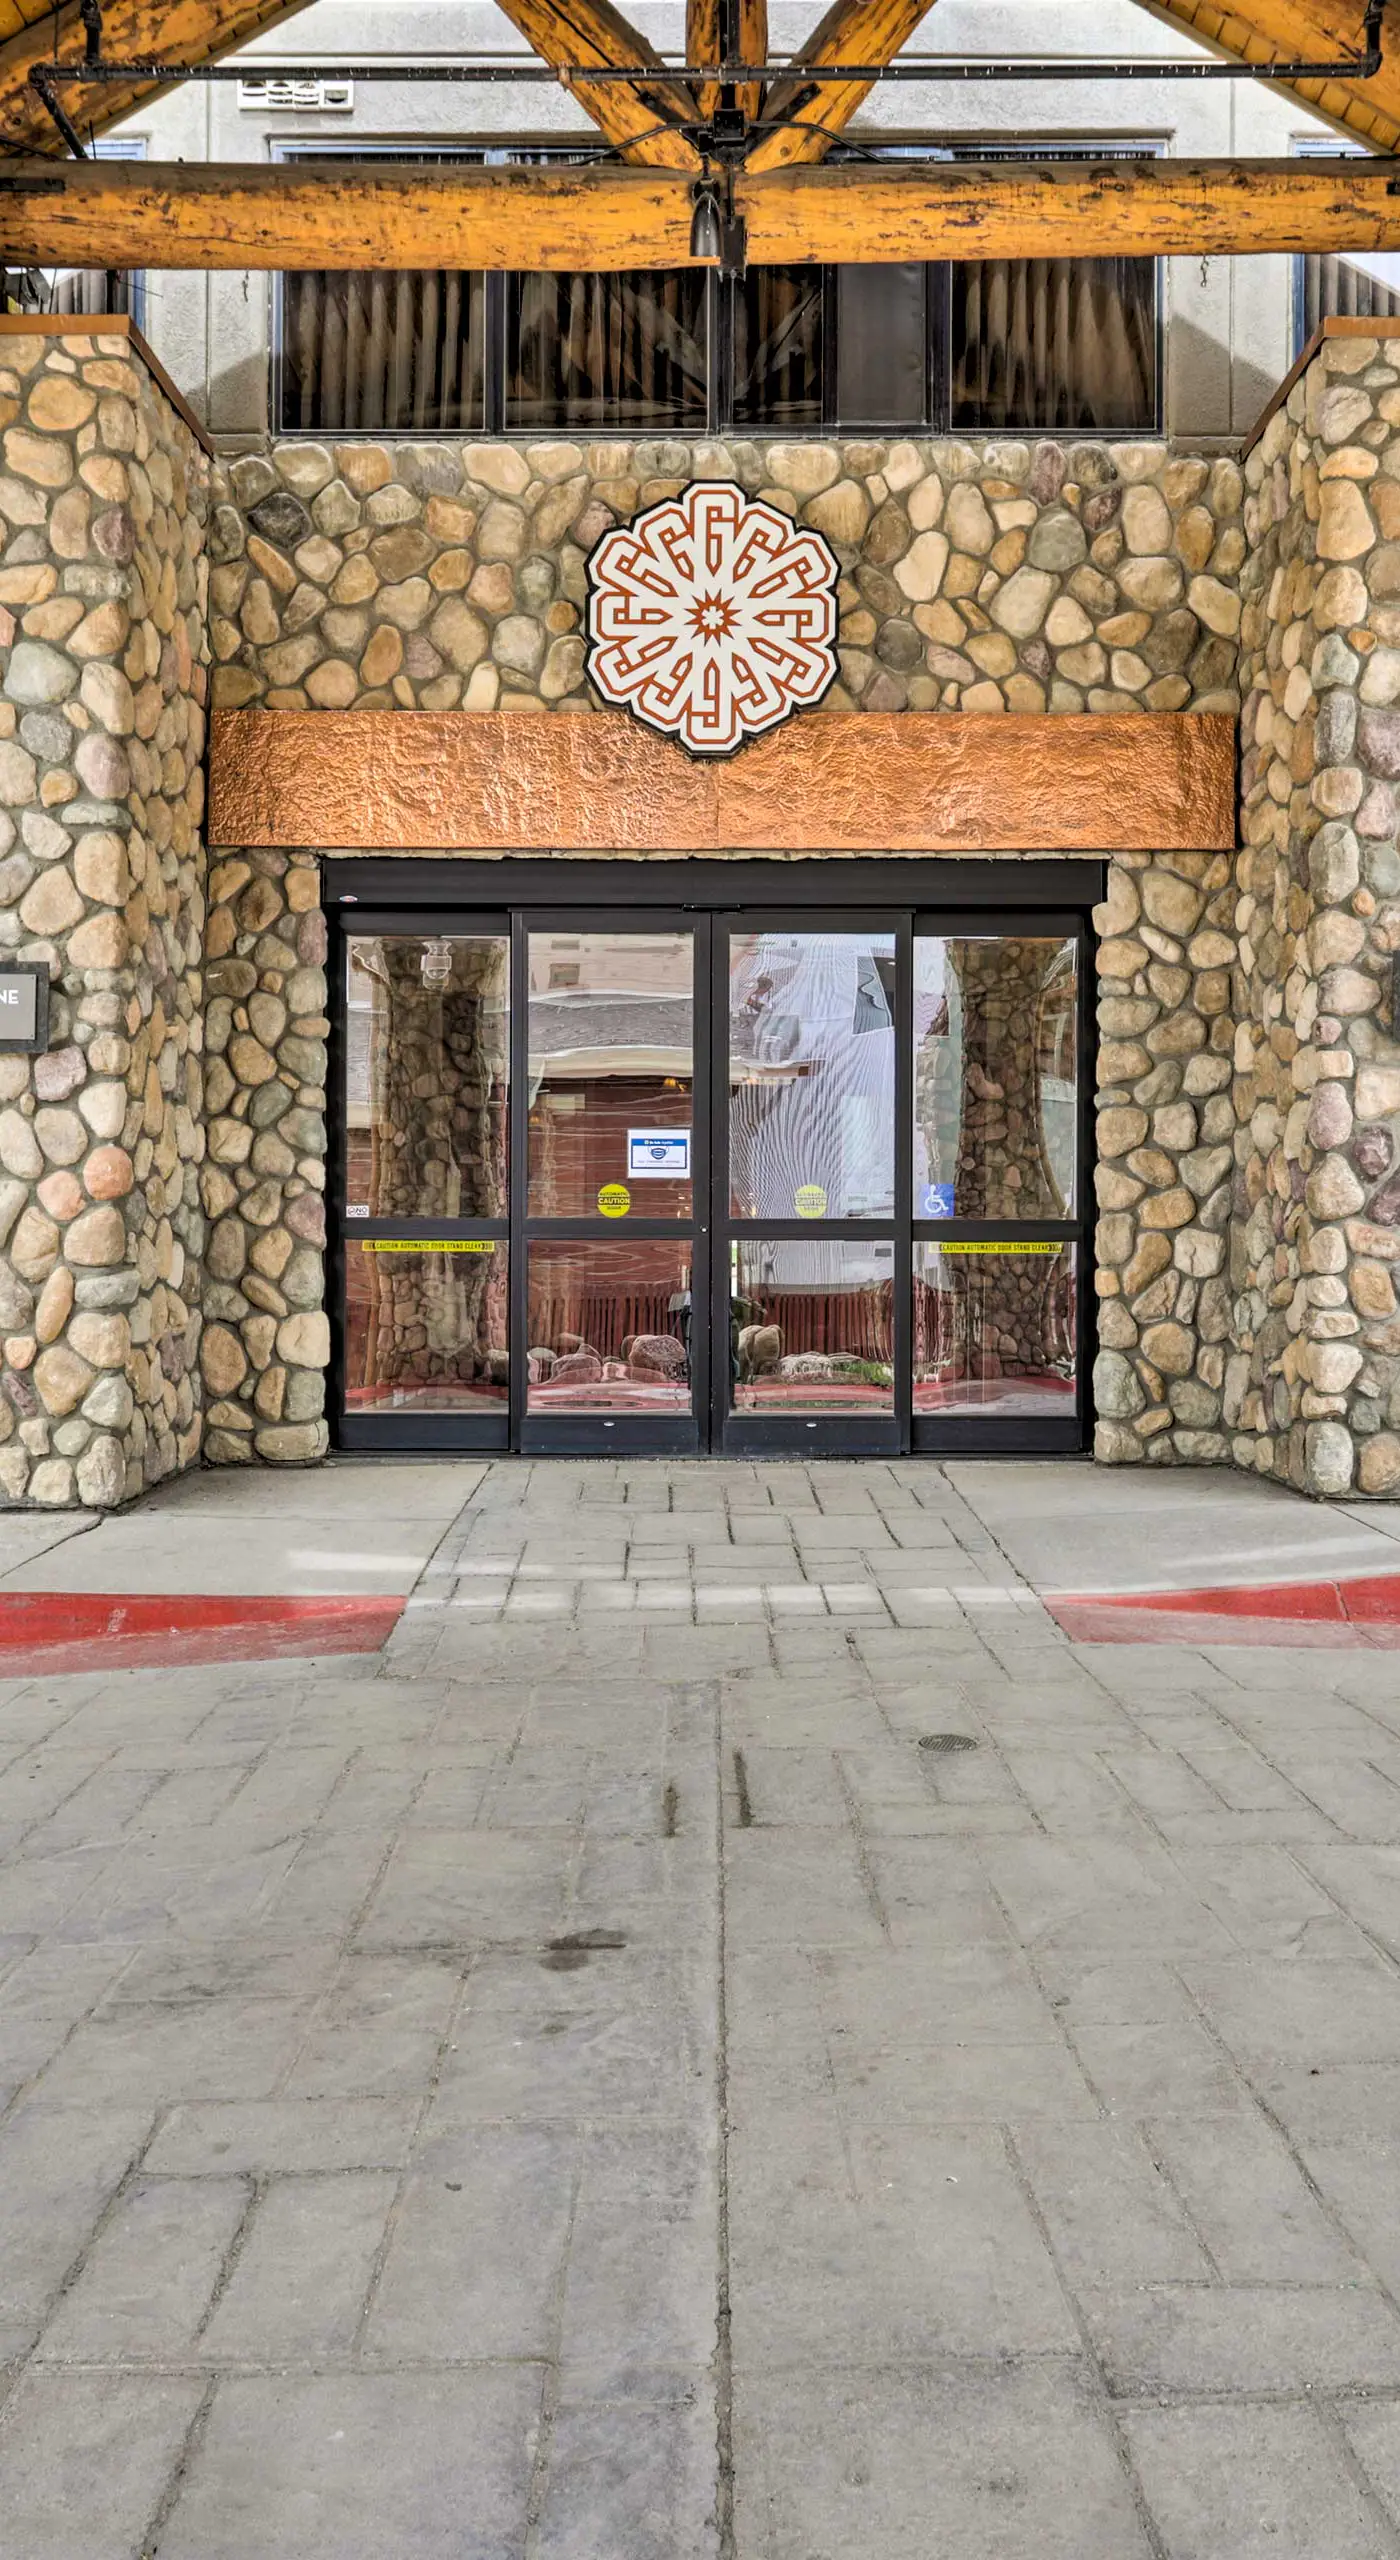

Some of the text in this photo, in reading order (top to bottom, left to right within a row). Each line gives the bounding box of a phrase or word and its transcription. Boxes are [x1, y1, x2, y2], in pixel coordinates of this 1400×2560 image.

[0, 989, 20, 1005] NE
[355, 1206, 368, 1214] NO
[943, 1243, 1048, 1251] CAUTION AUTOMATIC DOOR STAND CLEAR
